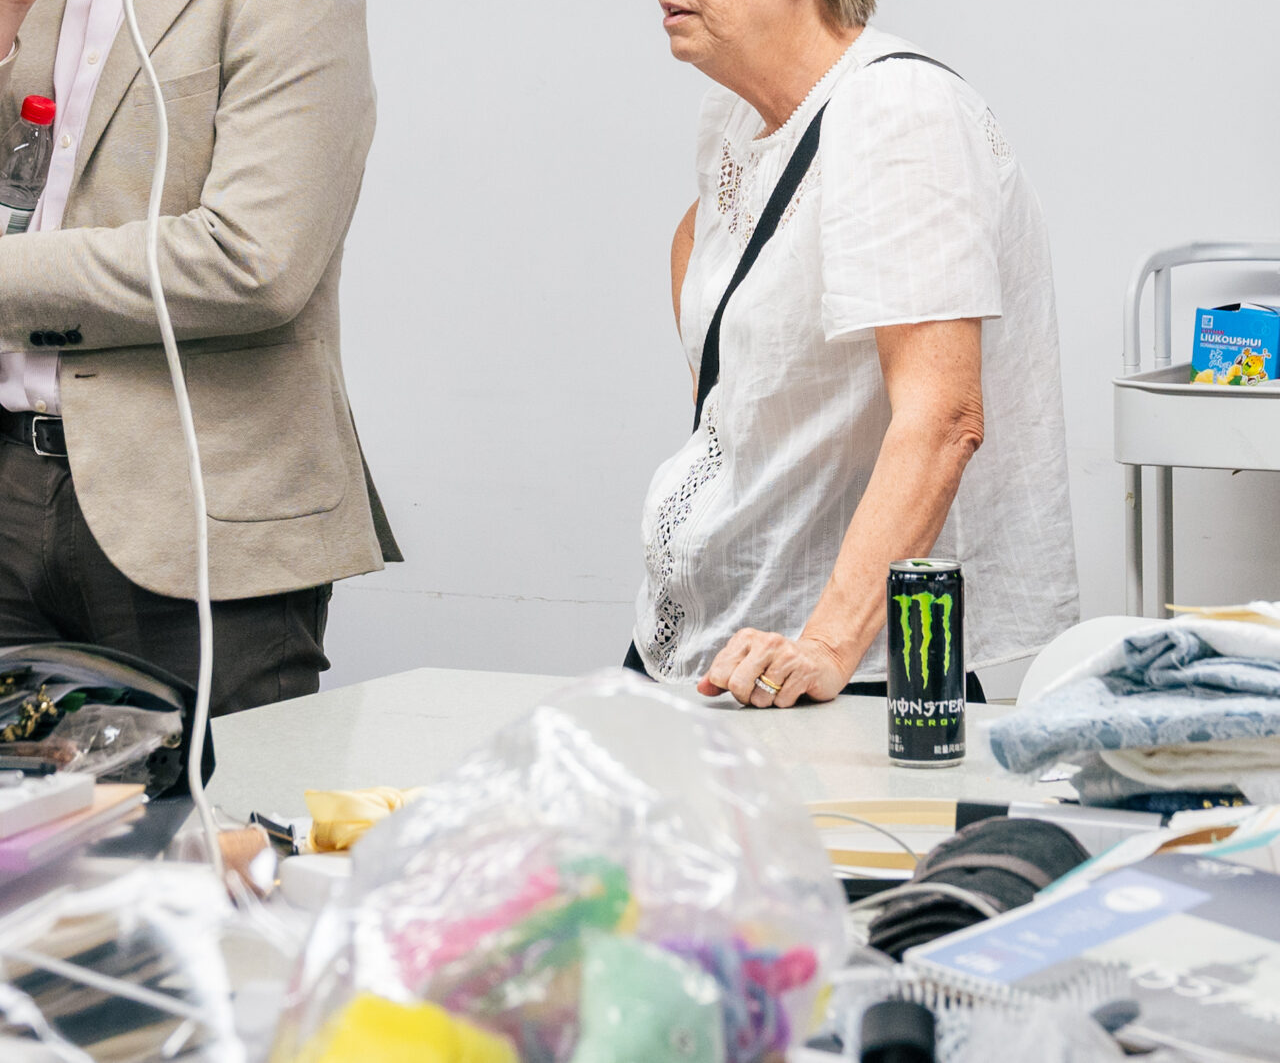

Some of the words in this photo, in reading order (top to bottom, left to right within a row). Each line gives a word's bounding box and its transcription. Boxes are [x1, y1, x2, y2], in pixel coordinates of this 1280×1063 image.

[1200, 334, 1262, 347] LIUKOUSHUI
[888, 697, 964, 716] MONSTER
[895, 718, 957, 728] ENERGY
